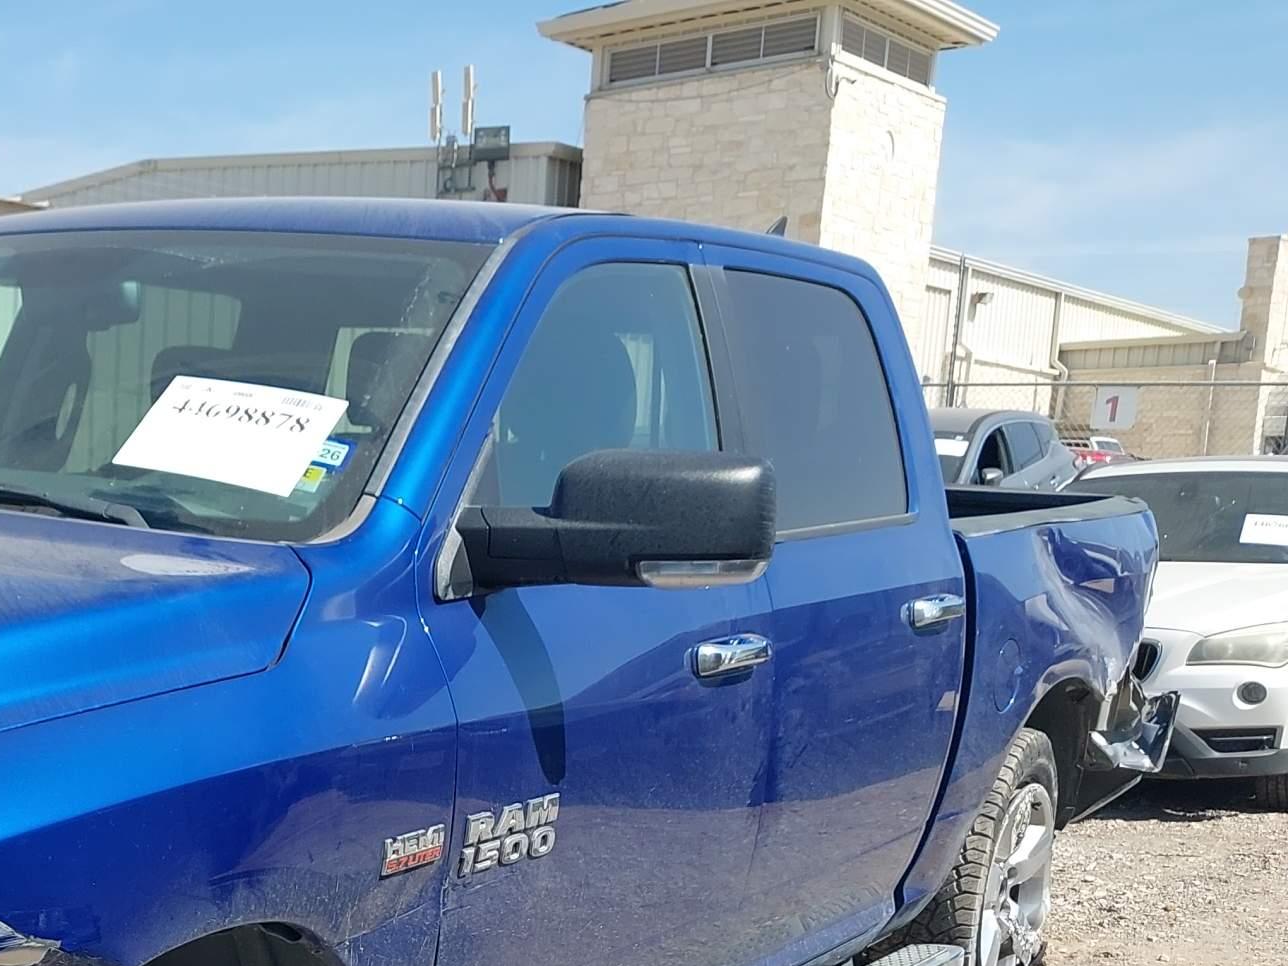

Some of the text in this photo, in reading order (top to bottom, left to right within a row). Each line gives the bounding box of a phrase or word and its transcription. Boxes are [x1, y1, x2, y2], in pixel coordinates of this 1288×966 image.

[1105, 395, 1120, 422] 1
[319, 448, 342, 461] 26
[465, 792, 560, 844] RAM
[384, 824, 445, 858] HEMI
[457, 825, 556, 879] 1500
